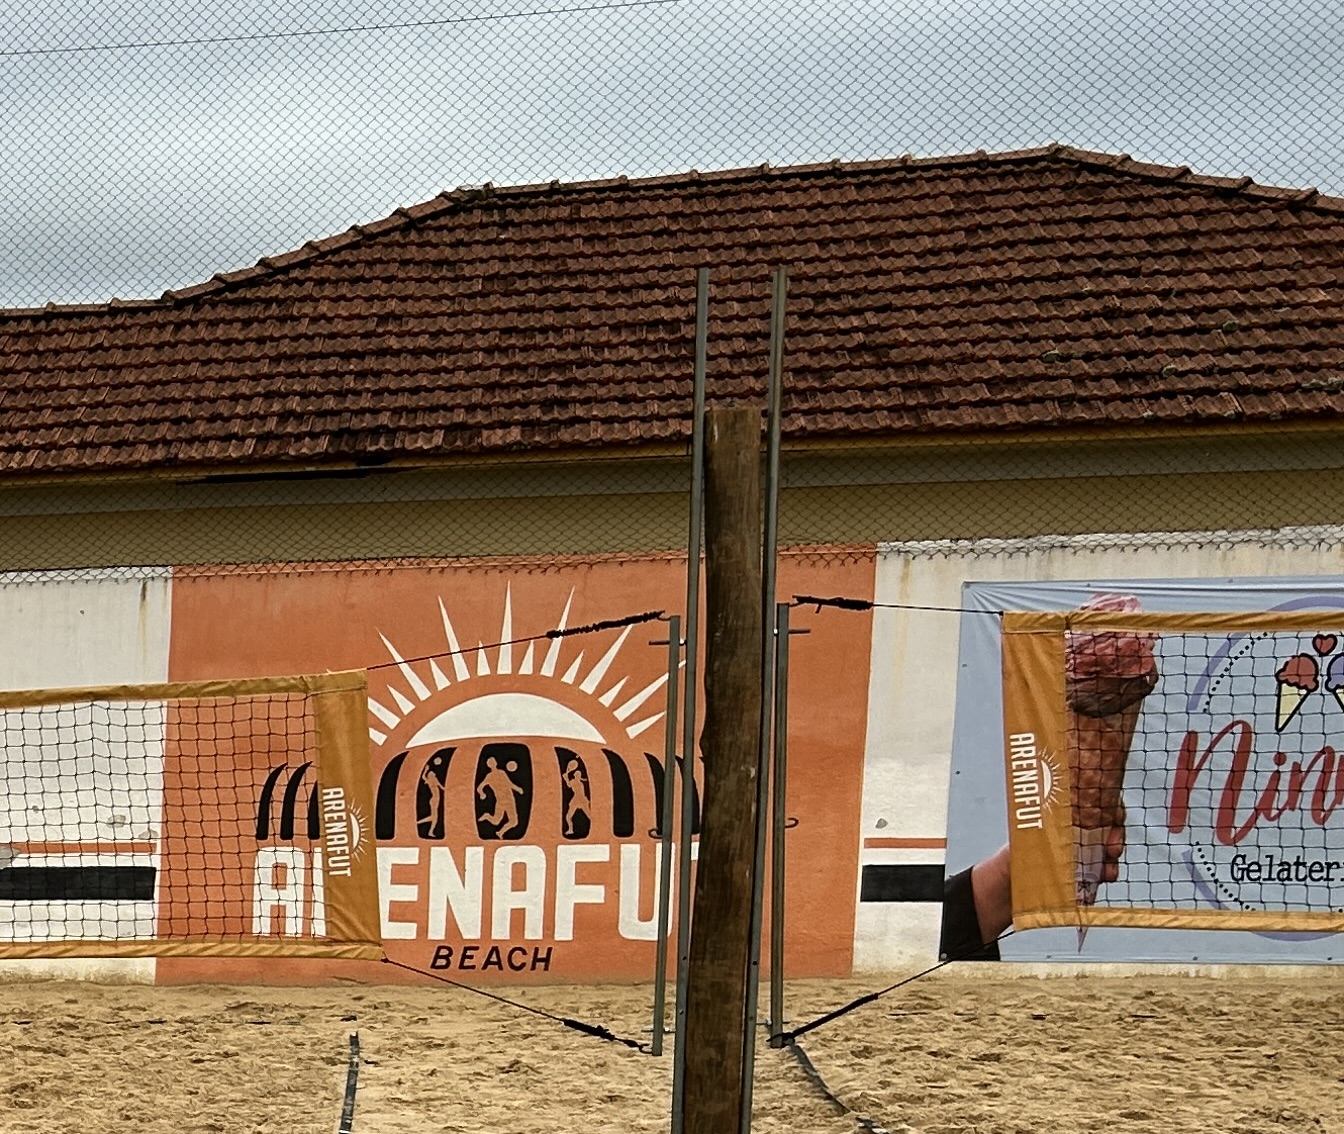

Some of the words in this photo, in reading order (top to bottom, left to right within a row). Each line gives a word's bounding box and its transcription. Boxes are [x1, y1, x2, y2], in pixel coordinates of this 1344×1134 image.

[1009, 732, 1043, 829] ARENAFUT
[322, 787, 352, 877] ARENAFUT
[1230, 854, 1344, 882] Gelater
[252, 841, 700, 942] AENAFU
[430, 945, 553, 972] BEACH
